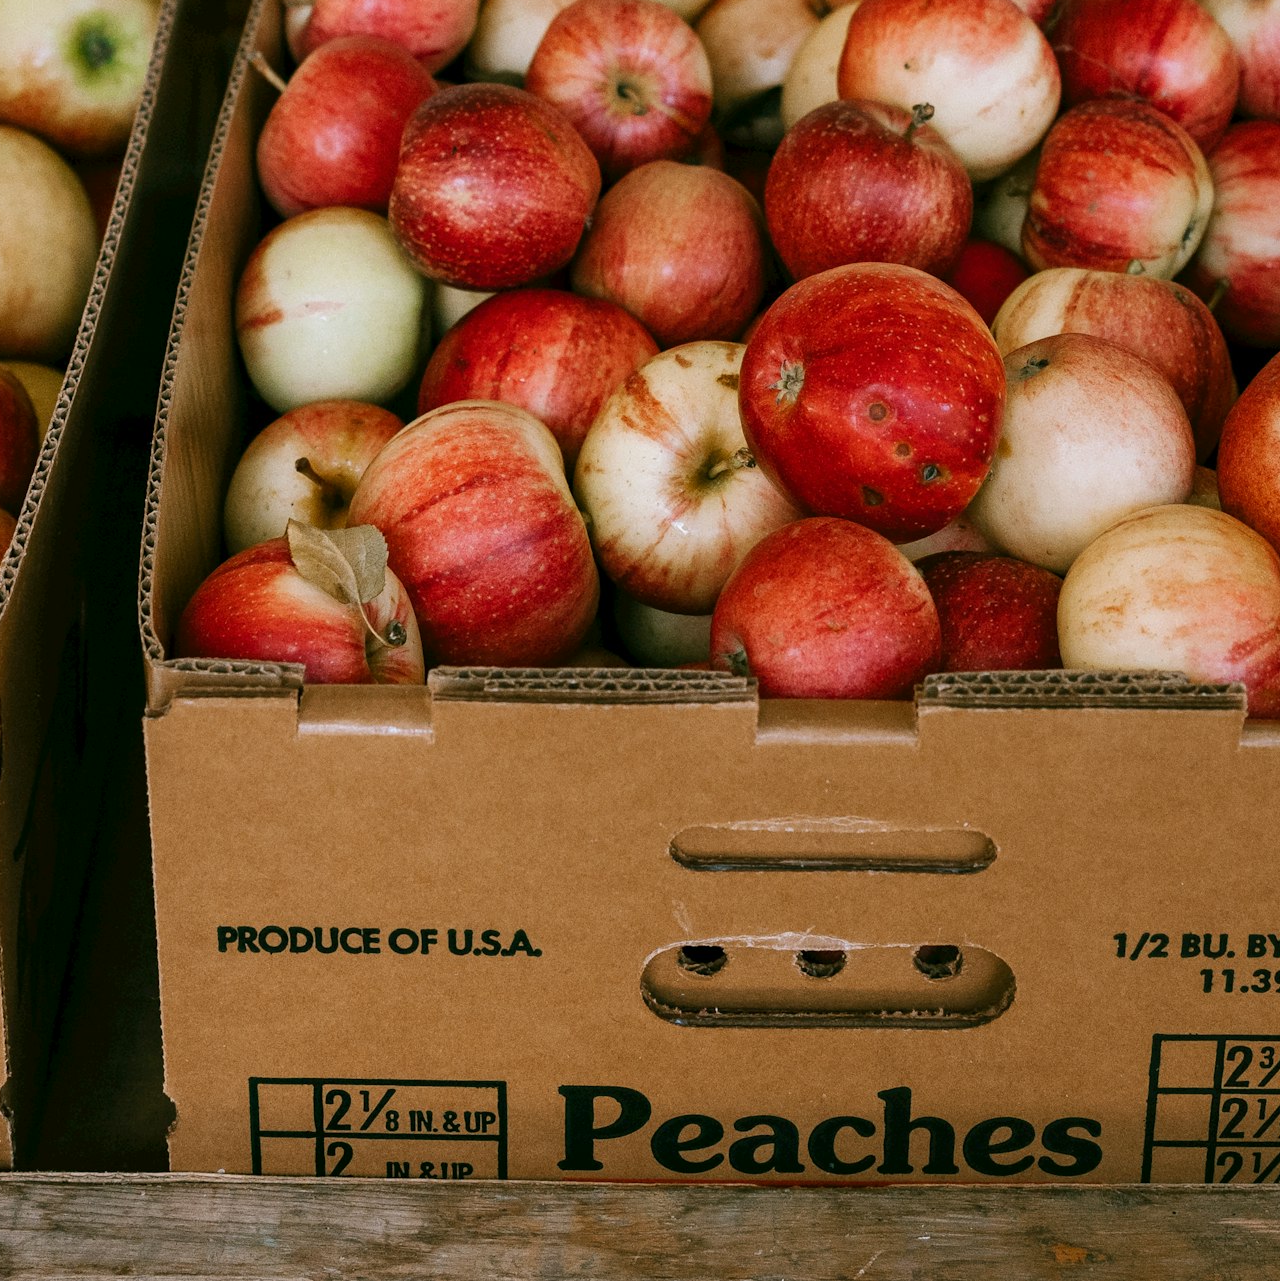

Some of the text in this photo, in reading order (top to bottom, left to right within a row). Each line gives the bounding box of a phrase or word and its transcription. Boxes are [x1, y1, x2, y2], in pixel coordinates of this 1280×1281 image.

[217, 925, 543, 957] PRODUCE OF U.S.A.
[1113, 932, 1170, 961] 1/2
[1180, 933, 1236, 959] BU.
[557, 1084, 1103, 1177] Peaches
